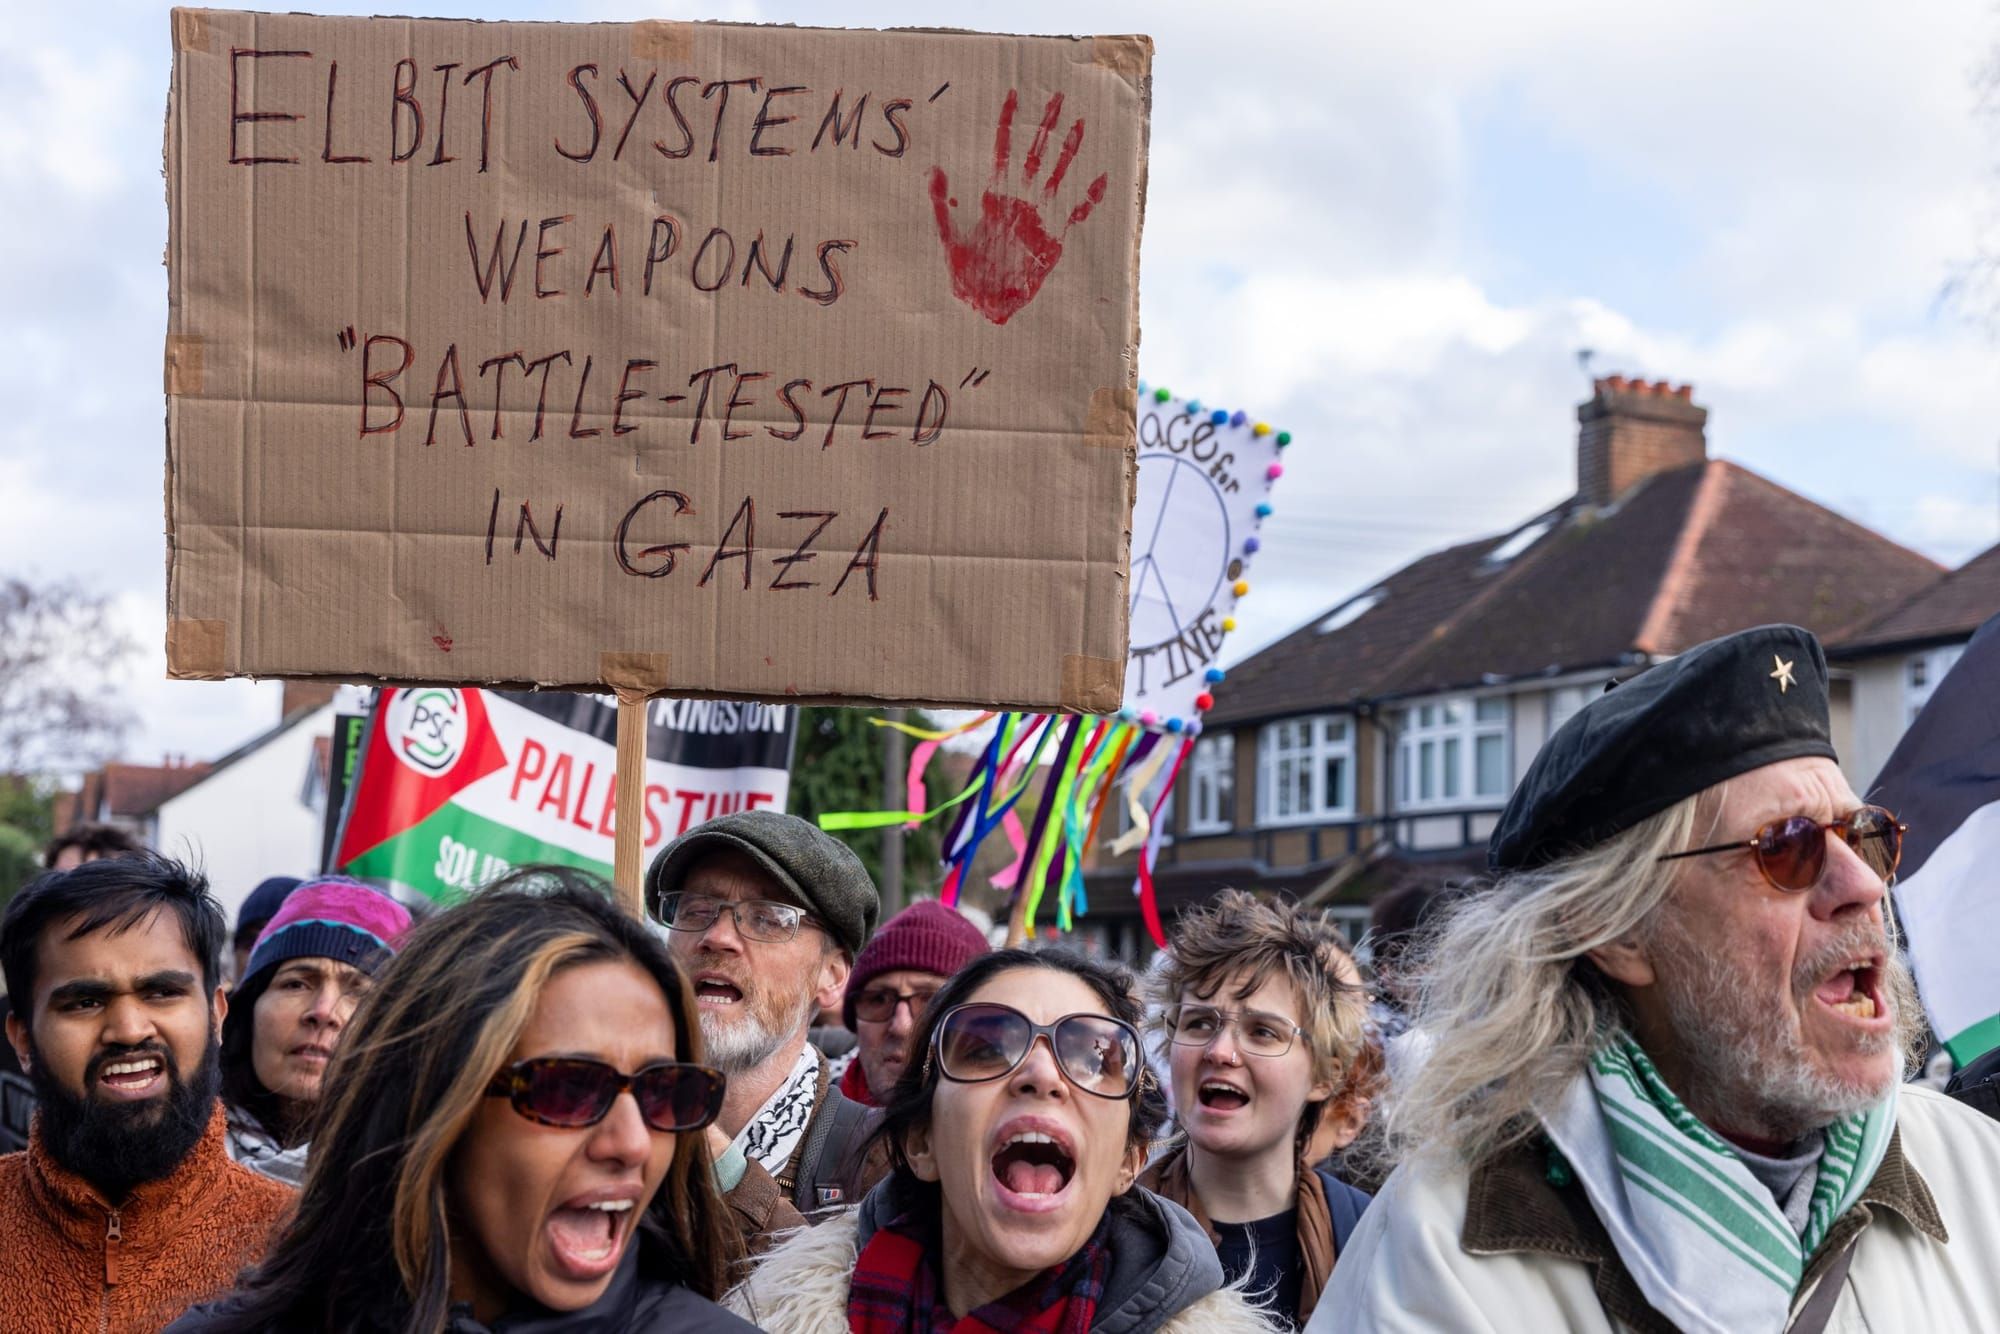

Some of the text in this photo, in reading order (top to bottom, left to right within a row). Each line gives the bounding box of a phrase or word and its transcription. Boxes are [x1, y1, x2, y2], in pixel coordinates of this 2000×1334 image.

[228, 46, 949, 173] ELBIT SYSTEMS'
[466, 211, 858, 306] WEAPONS
[337, 326, 990, 451] "BATTLE-TESTED"
[1139, 411, 1241, 495] ace for
[485, 488, 889, 602] IN GAZA
[1131, 607, 1222, 696] TINE
[409, 704, 453, 750] PSC
